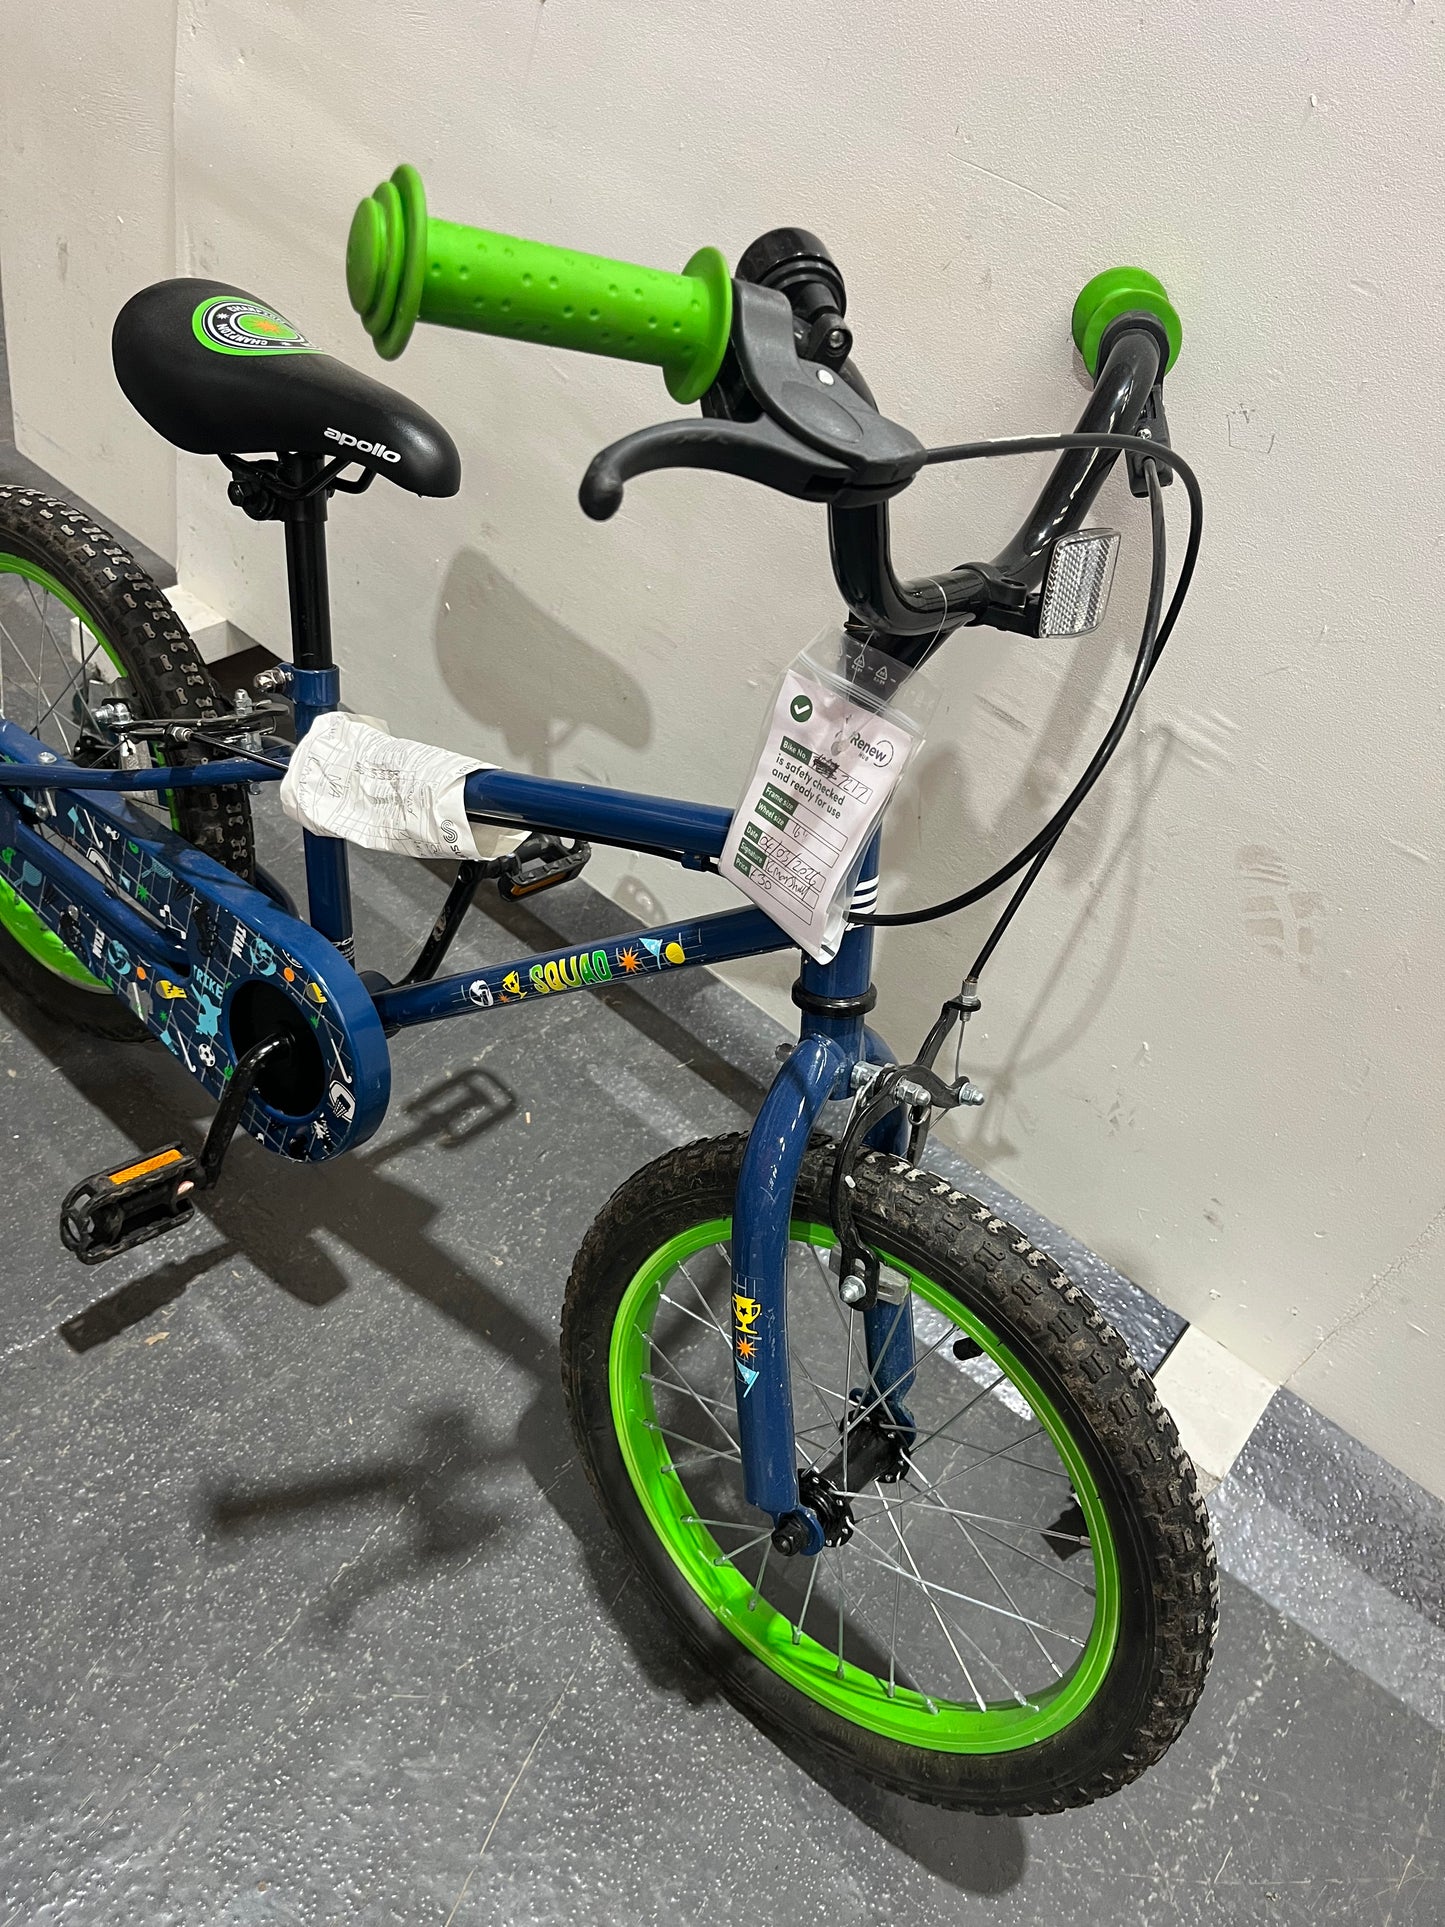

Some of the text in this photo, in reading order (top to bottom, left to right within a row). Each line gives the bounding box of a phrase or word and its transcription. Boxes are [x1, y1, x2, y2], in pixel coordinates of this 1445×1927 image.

[216, 323, 268, 346] CHAMPION
[324, 427, 402, 464] apollo
[782, 740, 808, 761] Bike No.
[850, 731, 887, 763] Renew
[776, 753, 784, 766] is
[785, 759, 812, 785] safety
[813, 778, 846, 806] checked
[766, 786, 794, 811] Frame size
[771, 768, 841, 820] and ready for use
[758, 802, 785, 827] Wheel size
[746, 825, 759, 840] Date
[740, 841, 763, 863] Signature
[736, 858, 749, 873] Price
[231, 924, 247, 958] TEAM
[529, 949, 613, 995] SQUAD
